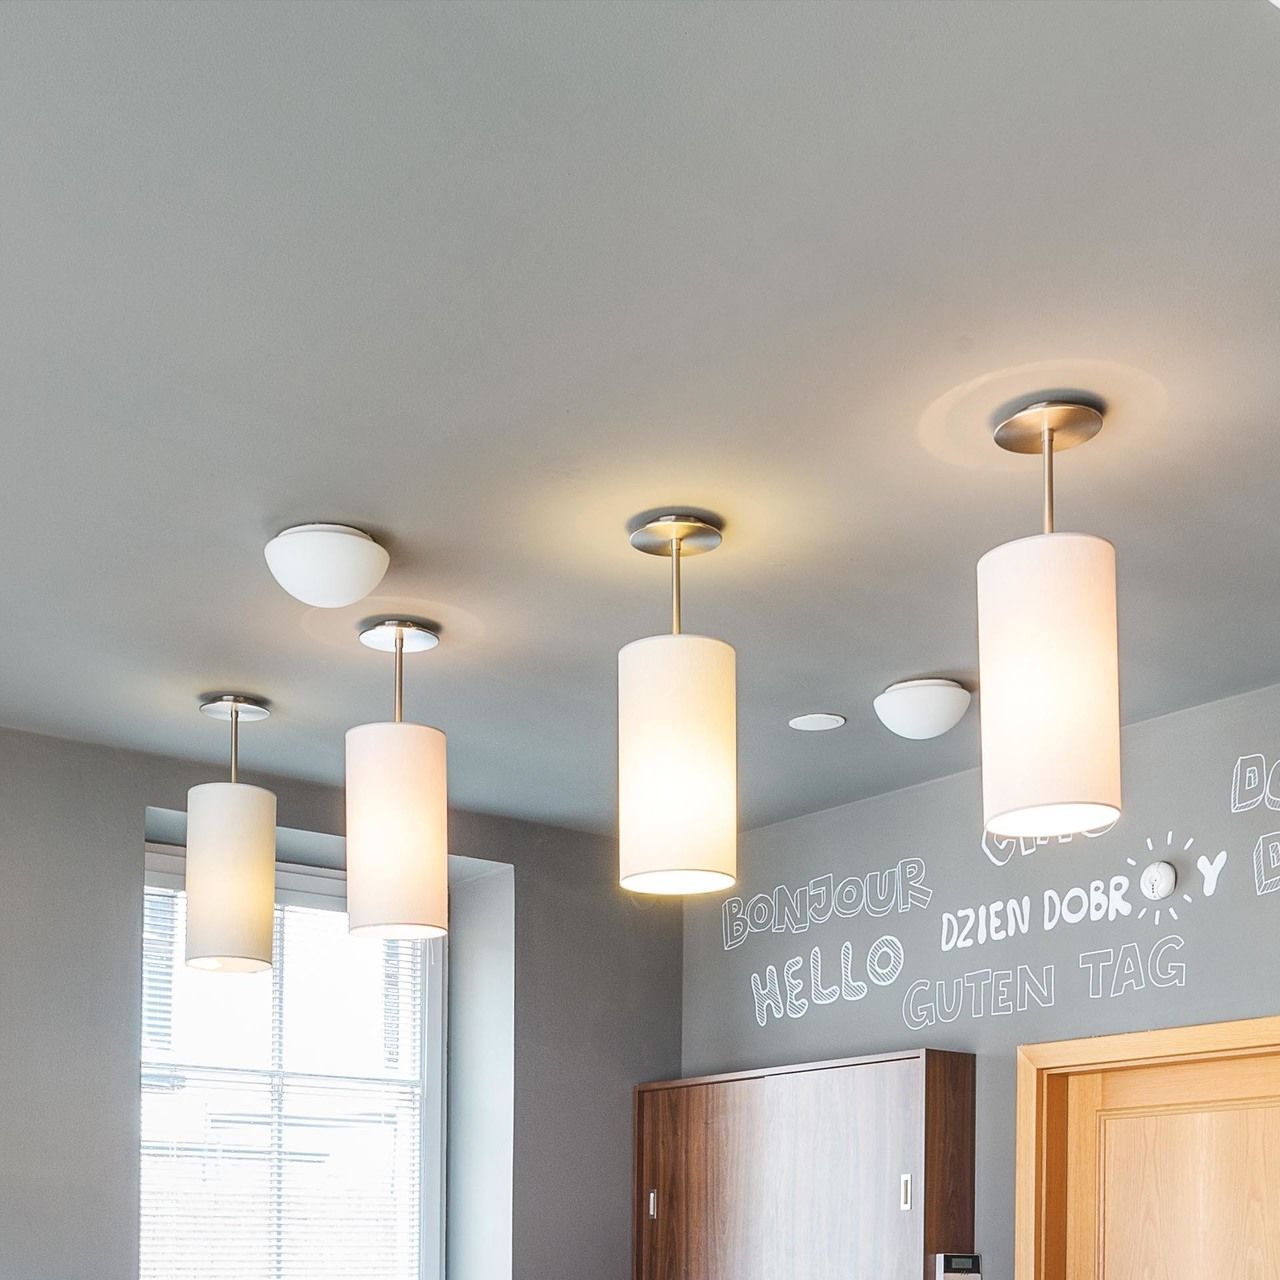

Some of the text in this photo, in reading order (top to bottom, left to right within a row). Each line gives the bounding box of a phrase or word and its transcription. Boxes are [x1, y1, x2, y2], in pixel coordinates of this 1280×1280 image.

[722, 856, 933, 951] BONJOUR
[751, 934, 905, 1027] HELLO
[902, 934, 1187, 1031] GUTEN TAG
